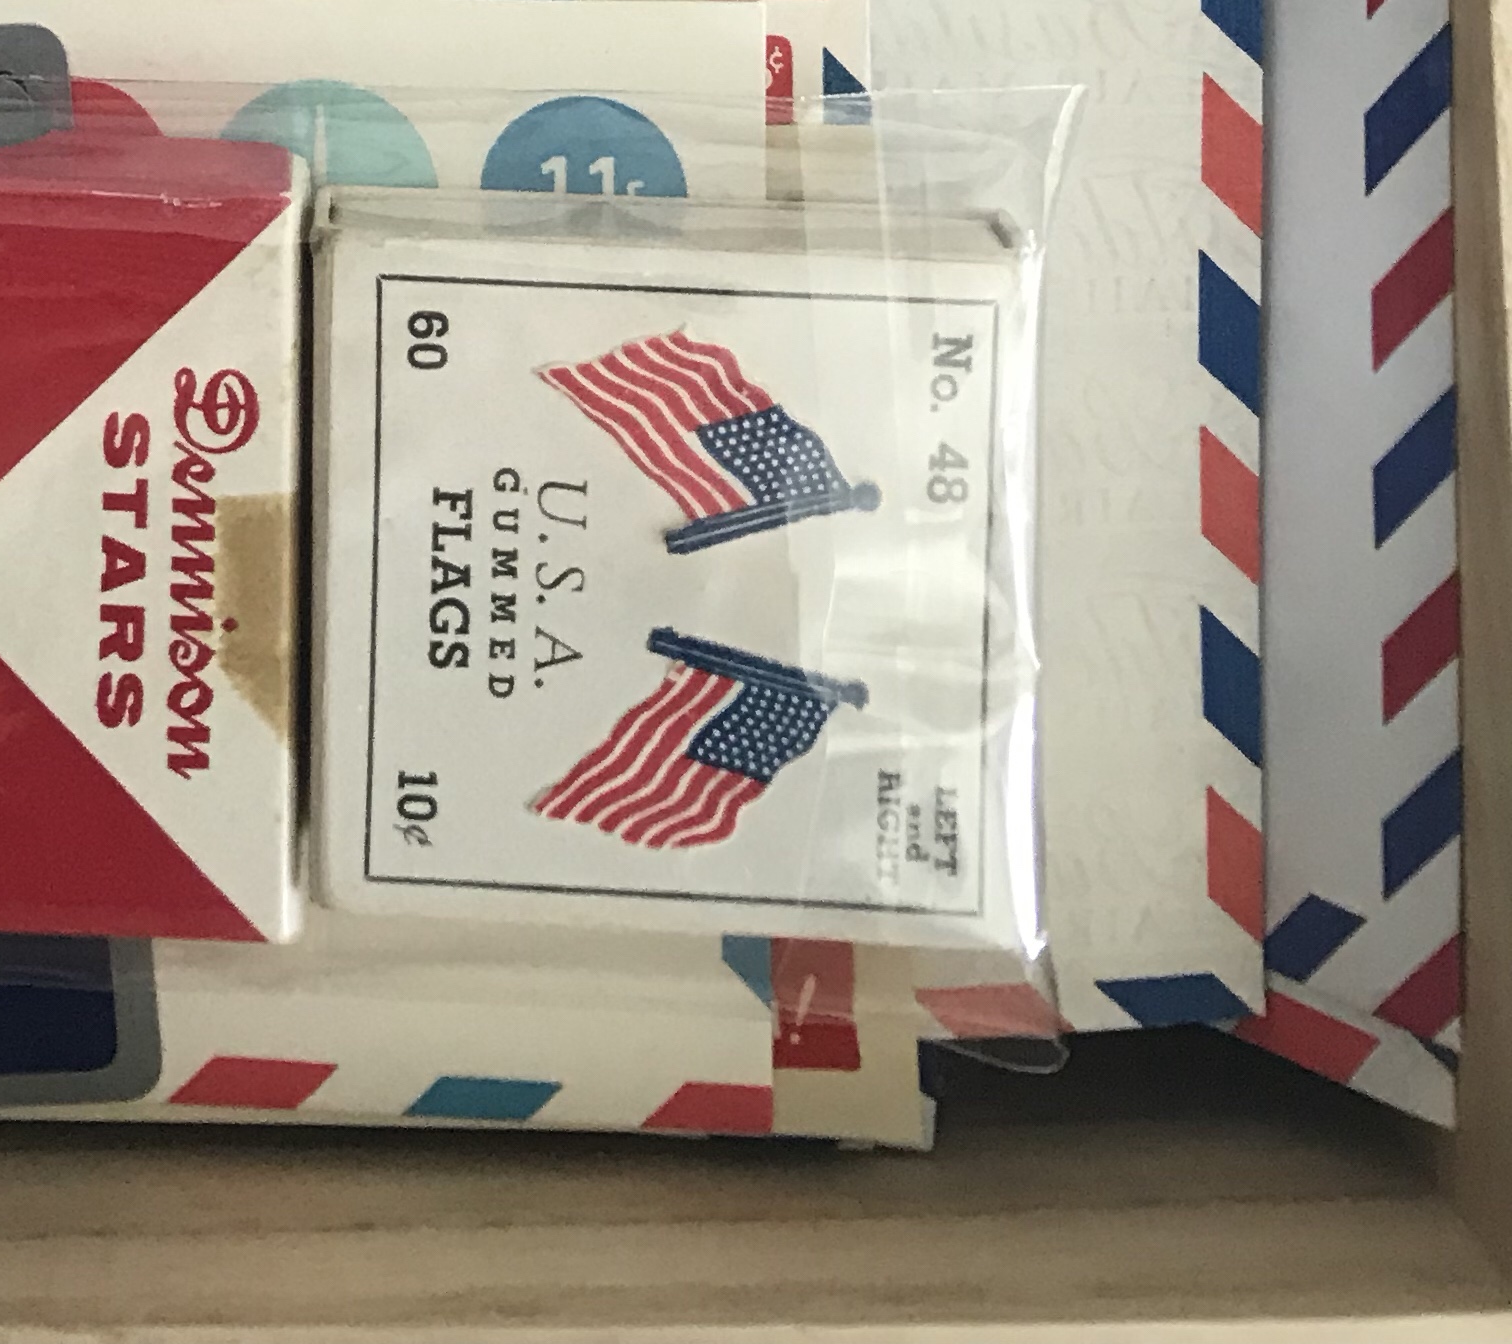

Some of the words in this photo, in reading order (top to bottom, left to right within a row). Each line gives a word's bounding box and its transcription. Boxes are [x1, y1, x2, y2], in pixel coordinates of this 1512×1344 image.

[406, 309, 450, 371] 60
[930, 333, 975, 414] No.
[926, 441, 971, 507] 48
[95, 411, 151, 730] STARS
[172, 367, 259, 782] Dennison
[428, 486, 475, 672] FLAGS
[488, 466, 523, 700] GUMMED
[395, 769, 440, 849] 10¢
[903, 802, 927, 864] and
[932, 783, 961, 879] LEFT
